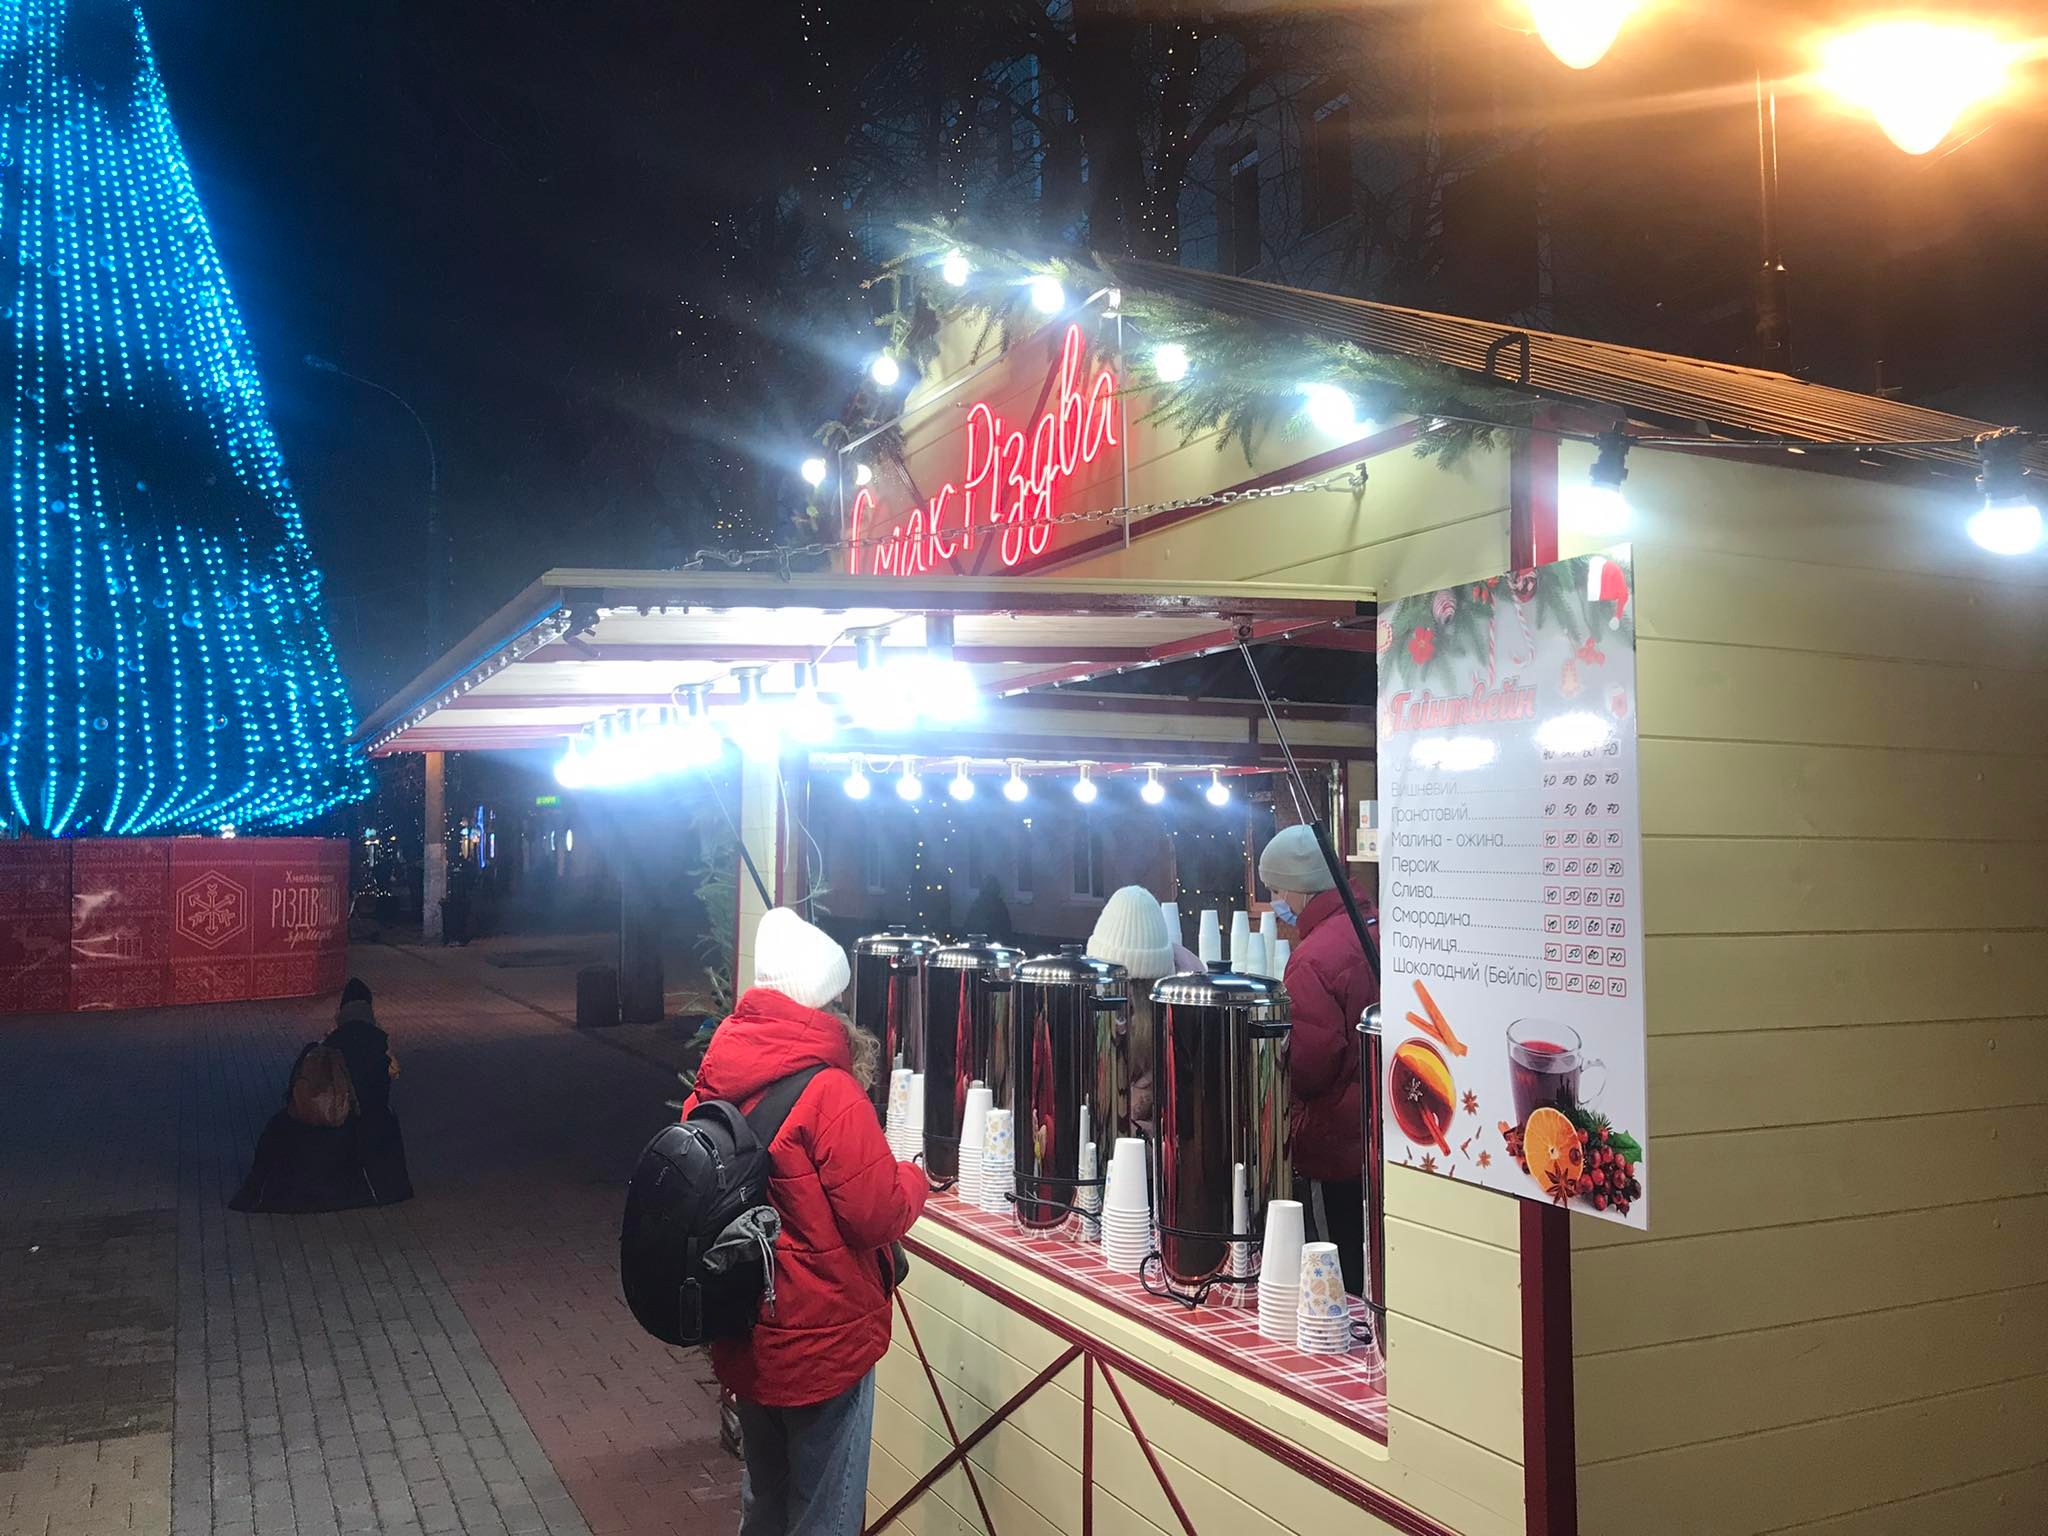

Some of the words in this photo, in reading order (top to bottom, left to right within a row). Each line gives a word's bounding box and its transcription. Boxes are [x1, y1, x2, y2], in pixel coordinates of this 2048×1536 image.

[964, 324, 1117, 566] Різдва
[1562, 775, 1577, 787] 50
[1583, 773, 1597, 787] 60
[1605, 772, 1619, 785] 70
[1392, 803, 1468, 823] Гранатовий
[1563, 803, 1577, 816] 50
[1585, 803, 1597, 816] 60
[1607, 803, 1619, 814] 70
[1392, 831, 1442, 848] Малина
[1456, 832, 1503, 847] ожина
[1564, 833, 1577, 844] 50
[1585, 832, 1598, 844] 60
[1607, 833, 1619, 844] 70
[1392, 857, 1440, 876] Персик
[1564, 862, 1578, 872] 50
[1585, 861, 1599, 873] 60
[1608, 862, 1621, 874] 70
[1392, 881, 1433, 899] Слива
[1566, 891, 1579, 901] 50
[1586, 891, 1599, 903] 60
[1609, 892, 1621, 904] 70
[1392, 906, 1470, 927] Смородина
[1567, 919, 1579, 930] 50
[1588, 920, 1599, 932] 60
[1610, 921, 1621, 933] 70
[1393, 932, 1457, 953] Полуниця
[1568, 947, 1580, 958] 50
[1588, 948, 1599, 960] 60
[1610, 951, 1622, 961] 70
[1393, 957, 1480, 981] Шоколадний
[1484, 964, 1543, 993] (Бейліс)
[1568, 976, 1579, 987] 50
[1589, 977, 1600, 990] 60
[1610, 980, 1622, 992] 70
